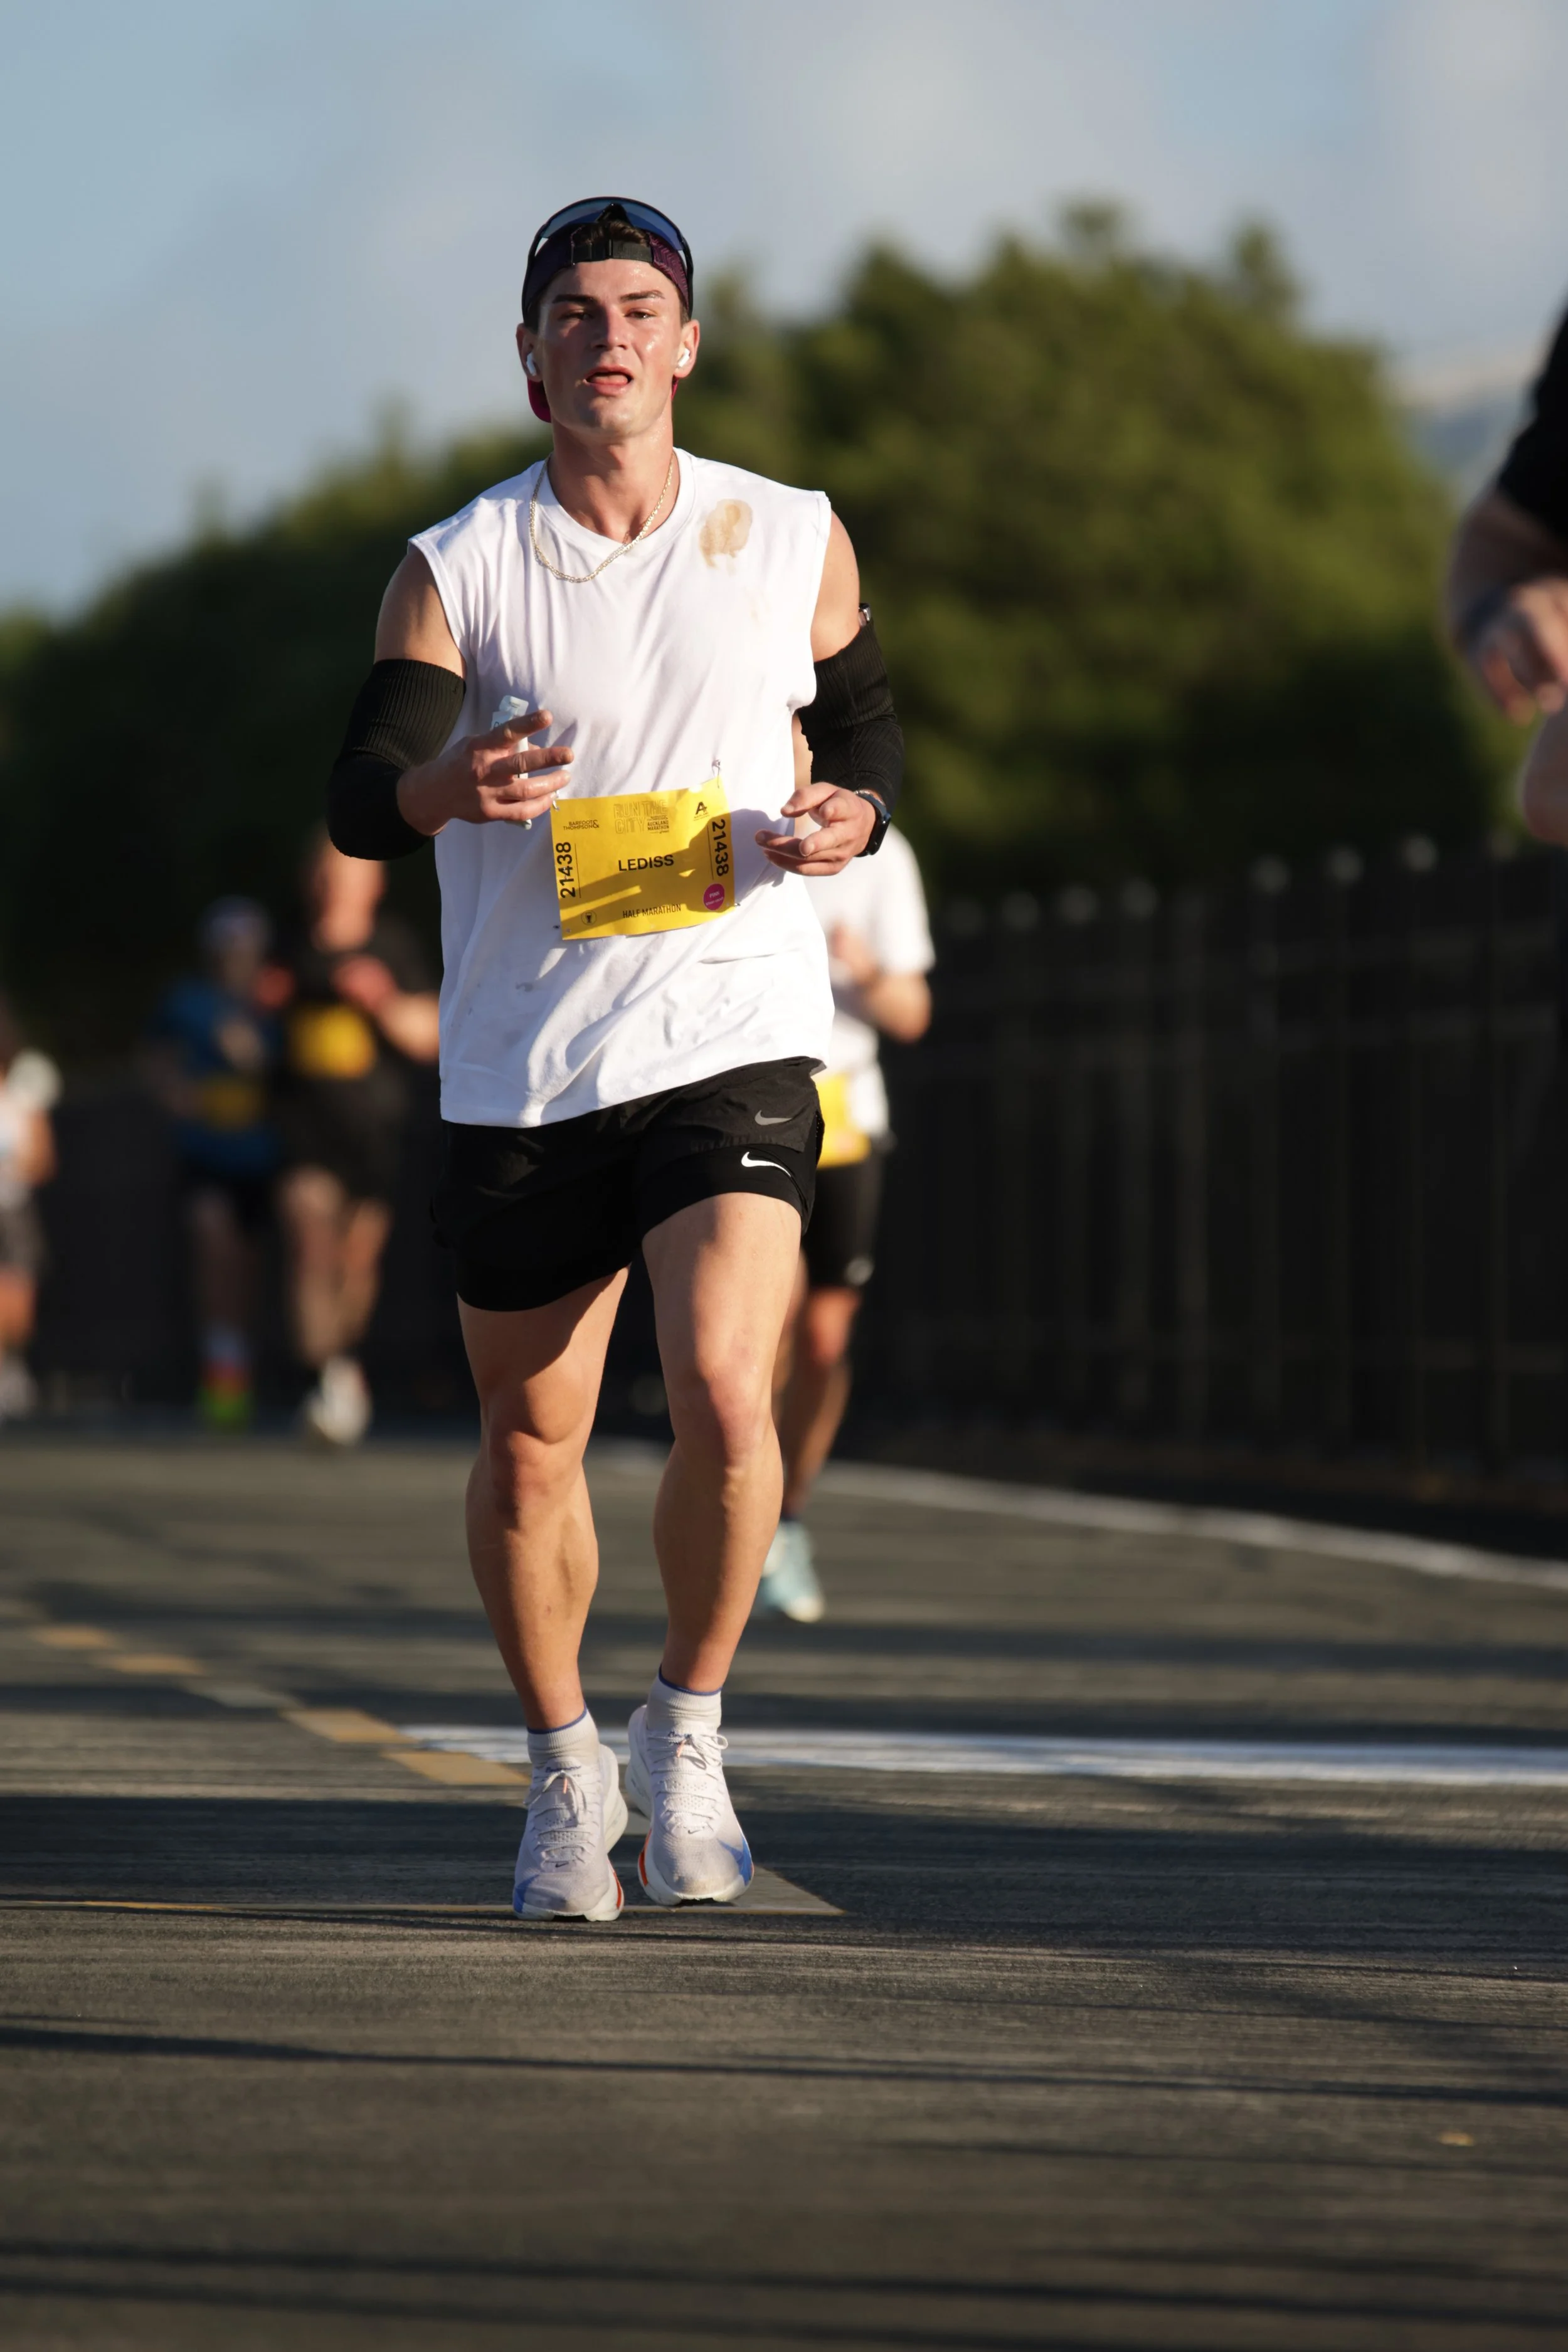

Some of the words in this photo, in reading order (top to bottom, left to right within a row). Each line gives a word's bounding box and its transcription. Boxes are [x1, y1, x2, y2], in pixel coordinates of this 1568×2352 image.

[613, 801, 639, 818] RUN
[615, 817, 645, 834] CITY
[712, 819, 729, 876] 21438
[556, 842, 576, 898] 21438
[618, 855, 674, 871] LEDISS
[622, 911, 640, 919] HALF
[642, 904, 681, 916] MARATHON
